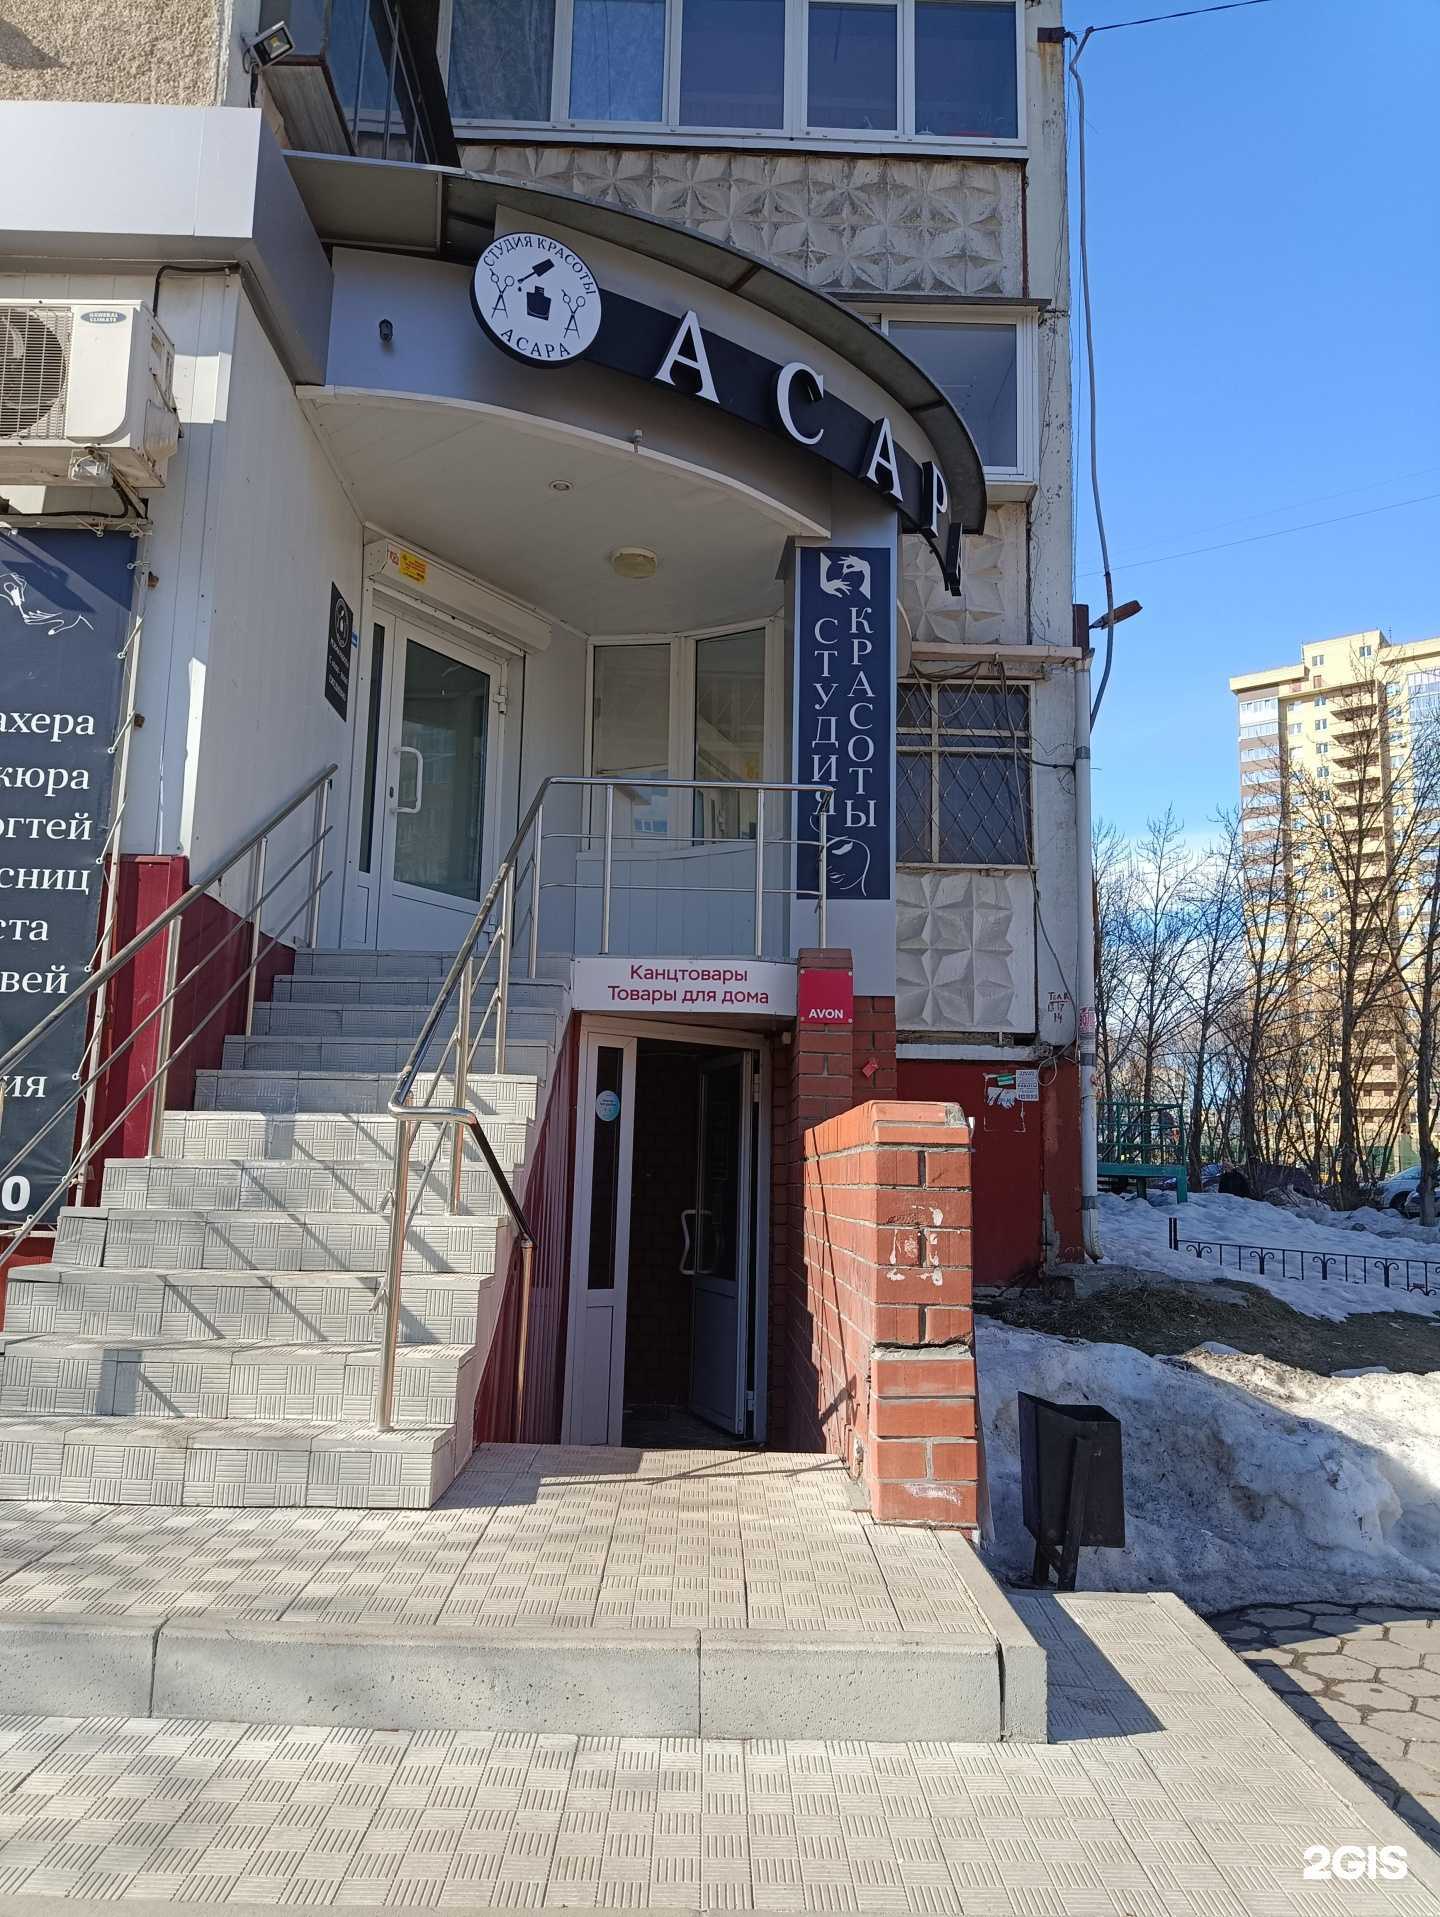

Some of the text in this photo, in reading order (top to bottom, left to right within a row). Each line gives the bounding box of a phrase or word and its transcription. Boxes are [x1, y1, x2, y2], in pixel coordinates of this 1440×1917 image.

[484, 236, 596, 295] СТУДИЯ КРАСОТЫ
[500, 329, 570, 358] АСАРА
[811, 618, 839, 815] СТУДИЯ
[844, 607, 877, 827] КРАСОТЫ
[0, 812, 93, 840] гтей
[0, 867, 91, 895] сниц
[0, 965, 70, 994] вей
[630, 965, 748, 984] Канцтовары
[607, 985, 769, 1004] Товары для дома
[808, 1008, 844, 1019] AVON
[1, 1175, 31, 1211] 0
